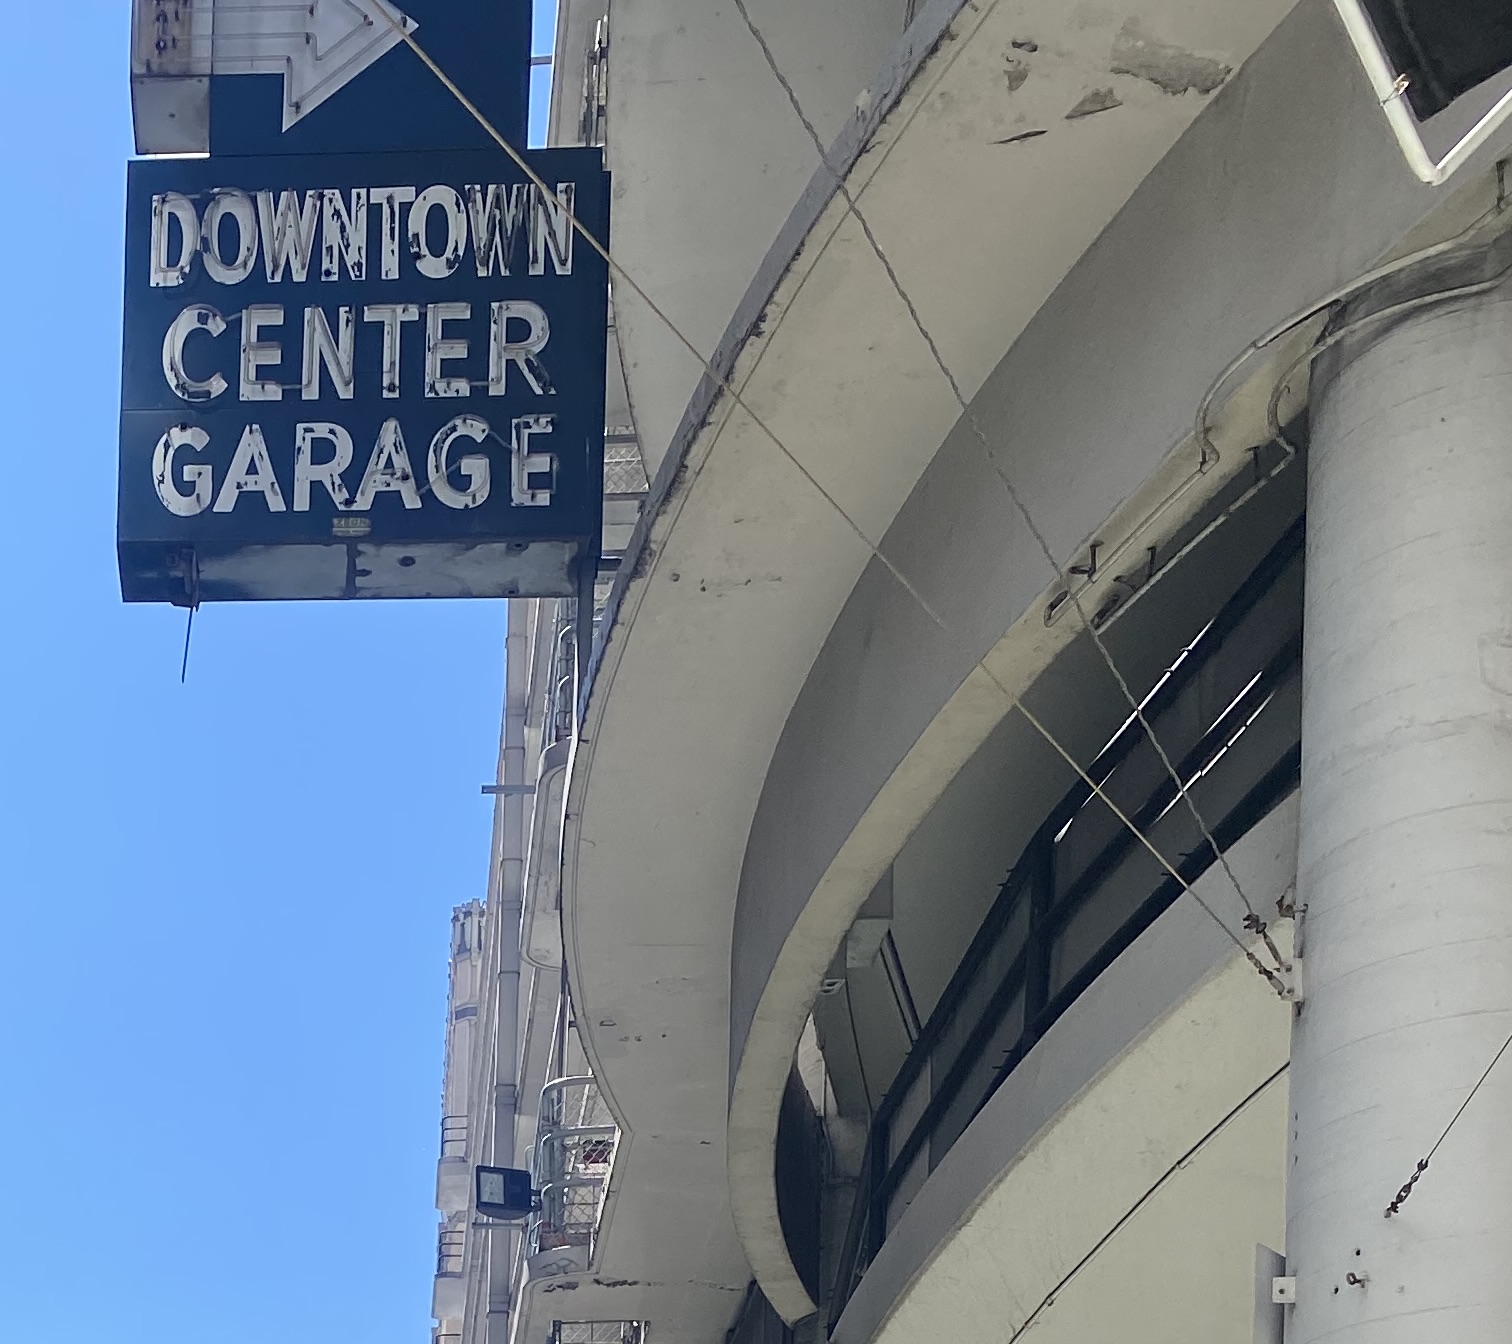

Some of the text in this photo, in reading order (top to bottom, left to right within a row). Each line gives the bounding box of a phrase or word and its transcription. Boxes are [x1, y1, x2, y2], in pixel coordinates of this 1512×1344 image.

[149, 182, 575, 288] DOWNTOWN
[161, 300, 556, 403] CENTER
[152, 414, 557, 518] GARAGE
